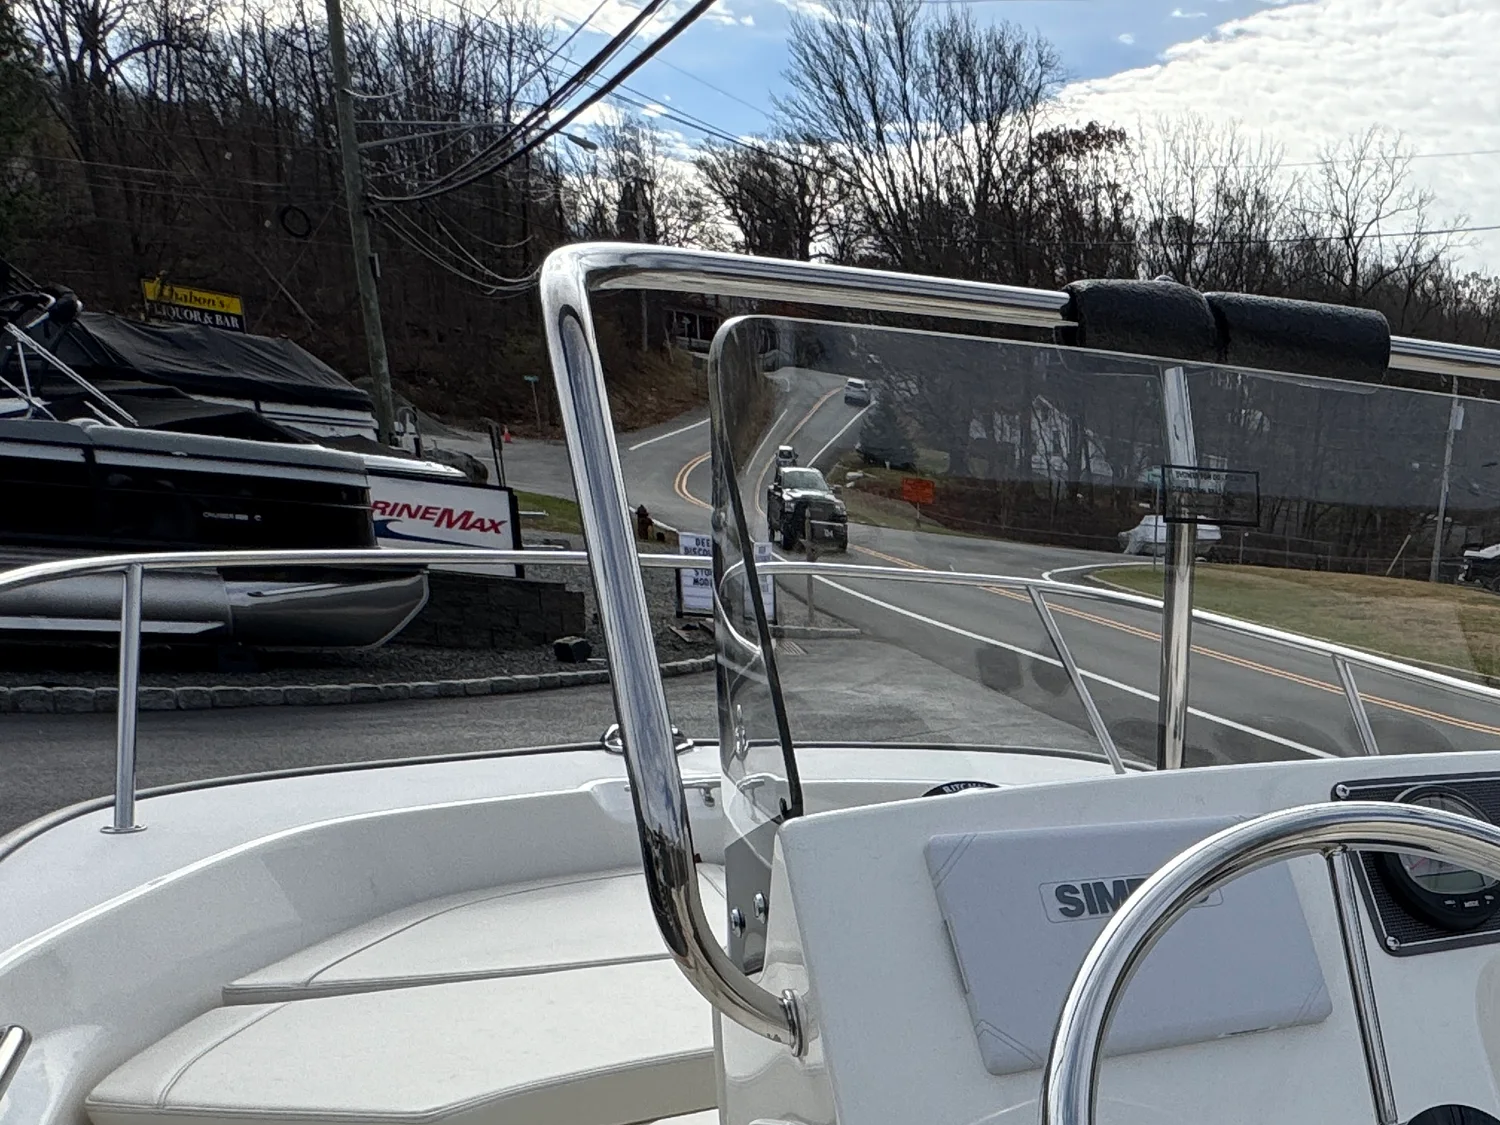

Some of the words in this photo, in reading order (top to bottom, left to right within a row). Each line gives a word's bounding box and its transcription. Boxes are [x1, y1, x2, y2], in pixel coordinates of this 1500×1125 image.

[215, 314, 240, 329] BAR
[370, 499, 507, 534] RINEMAX
[1055, 878, 1148, 918] SIM
